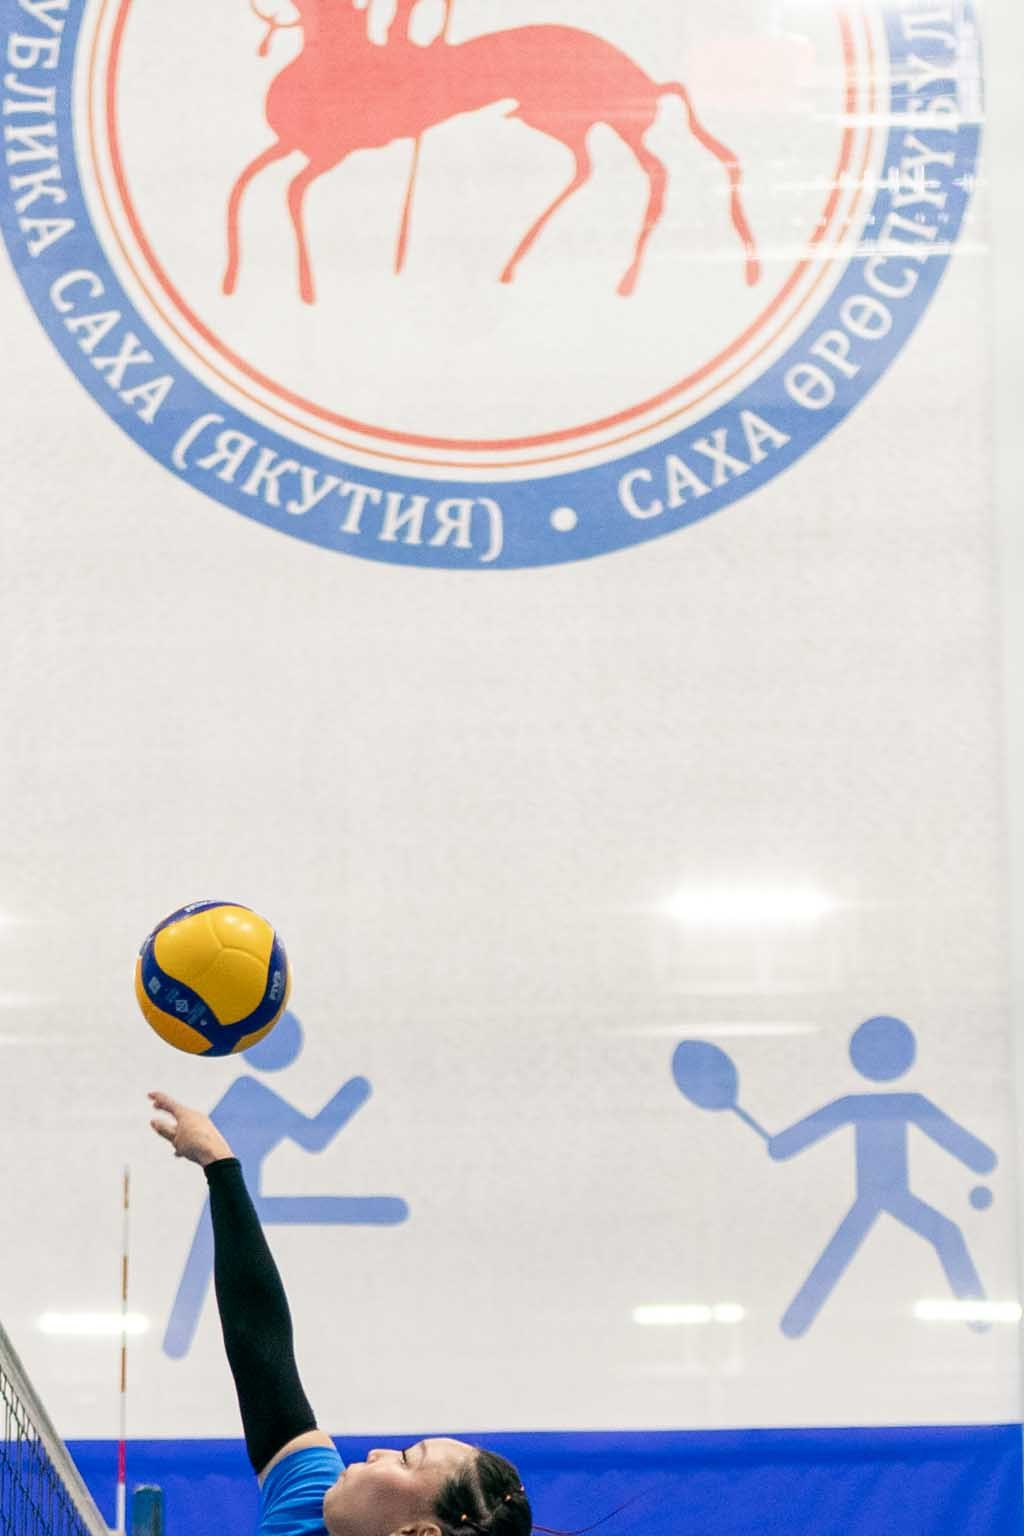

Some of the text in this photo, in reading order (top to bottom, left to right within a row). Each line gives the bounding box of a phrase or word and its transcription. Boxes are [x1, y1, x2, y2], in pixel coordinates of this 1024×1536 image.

[50, 269, 175, 425] САХА
[171, 413, 505, 563] (ЯКУТИЯ)
[618, 409, 792, 520] САХА
